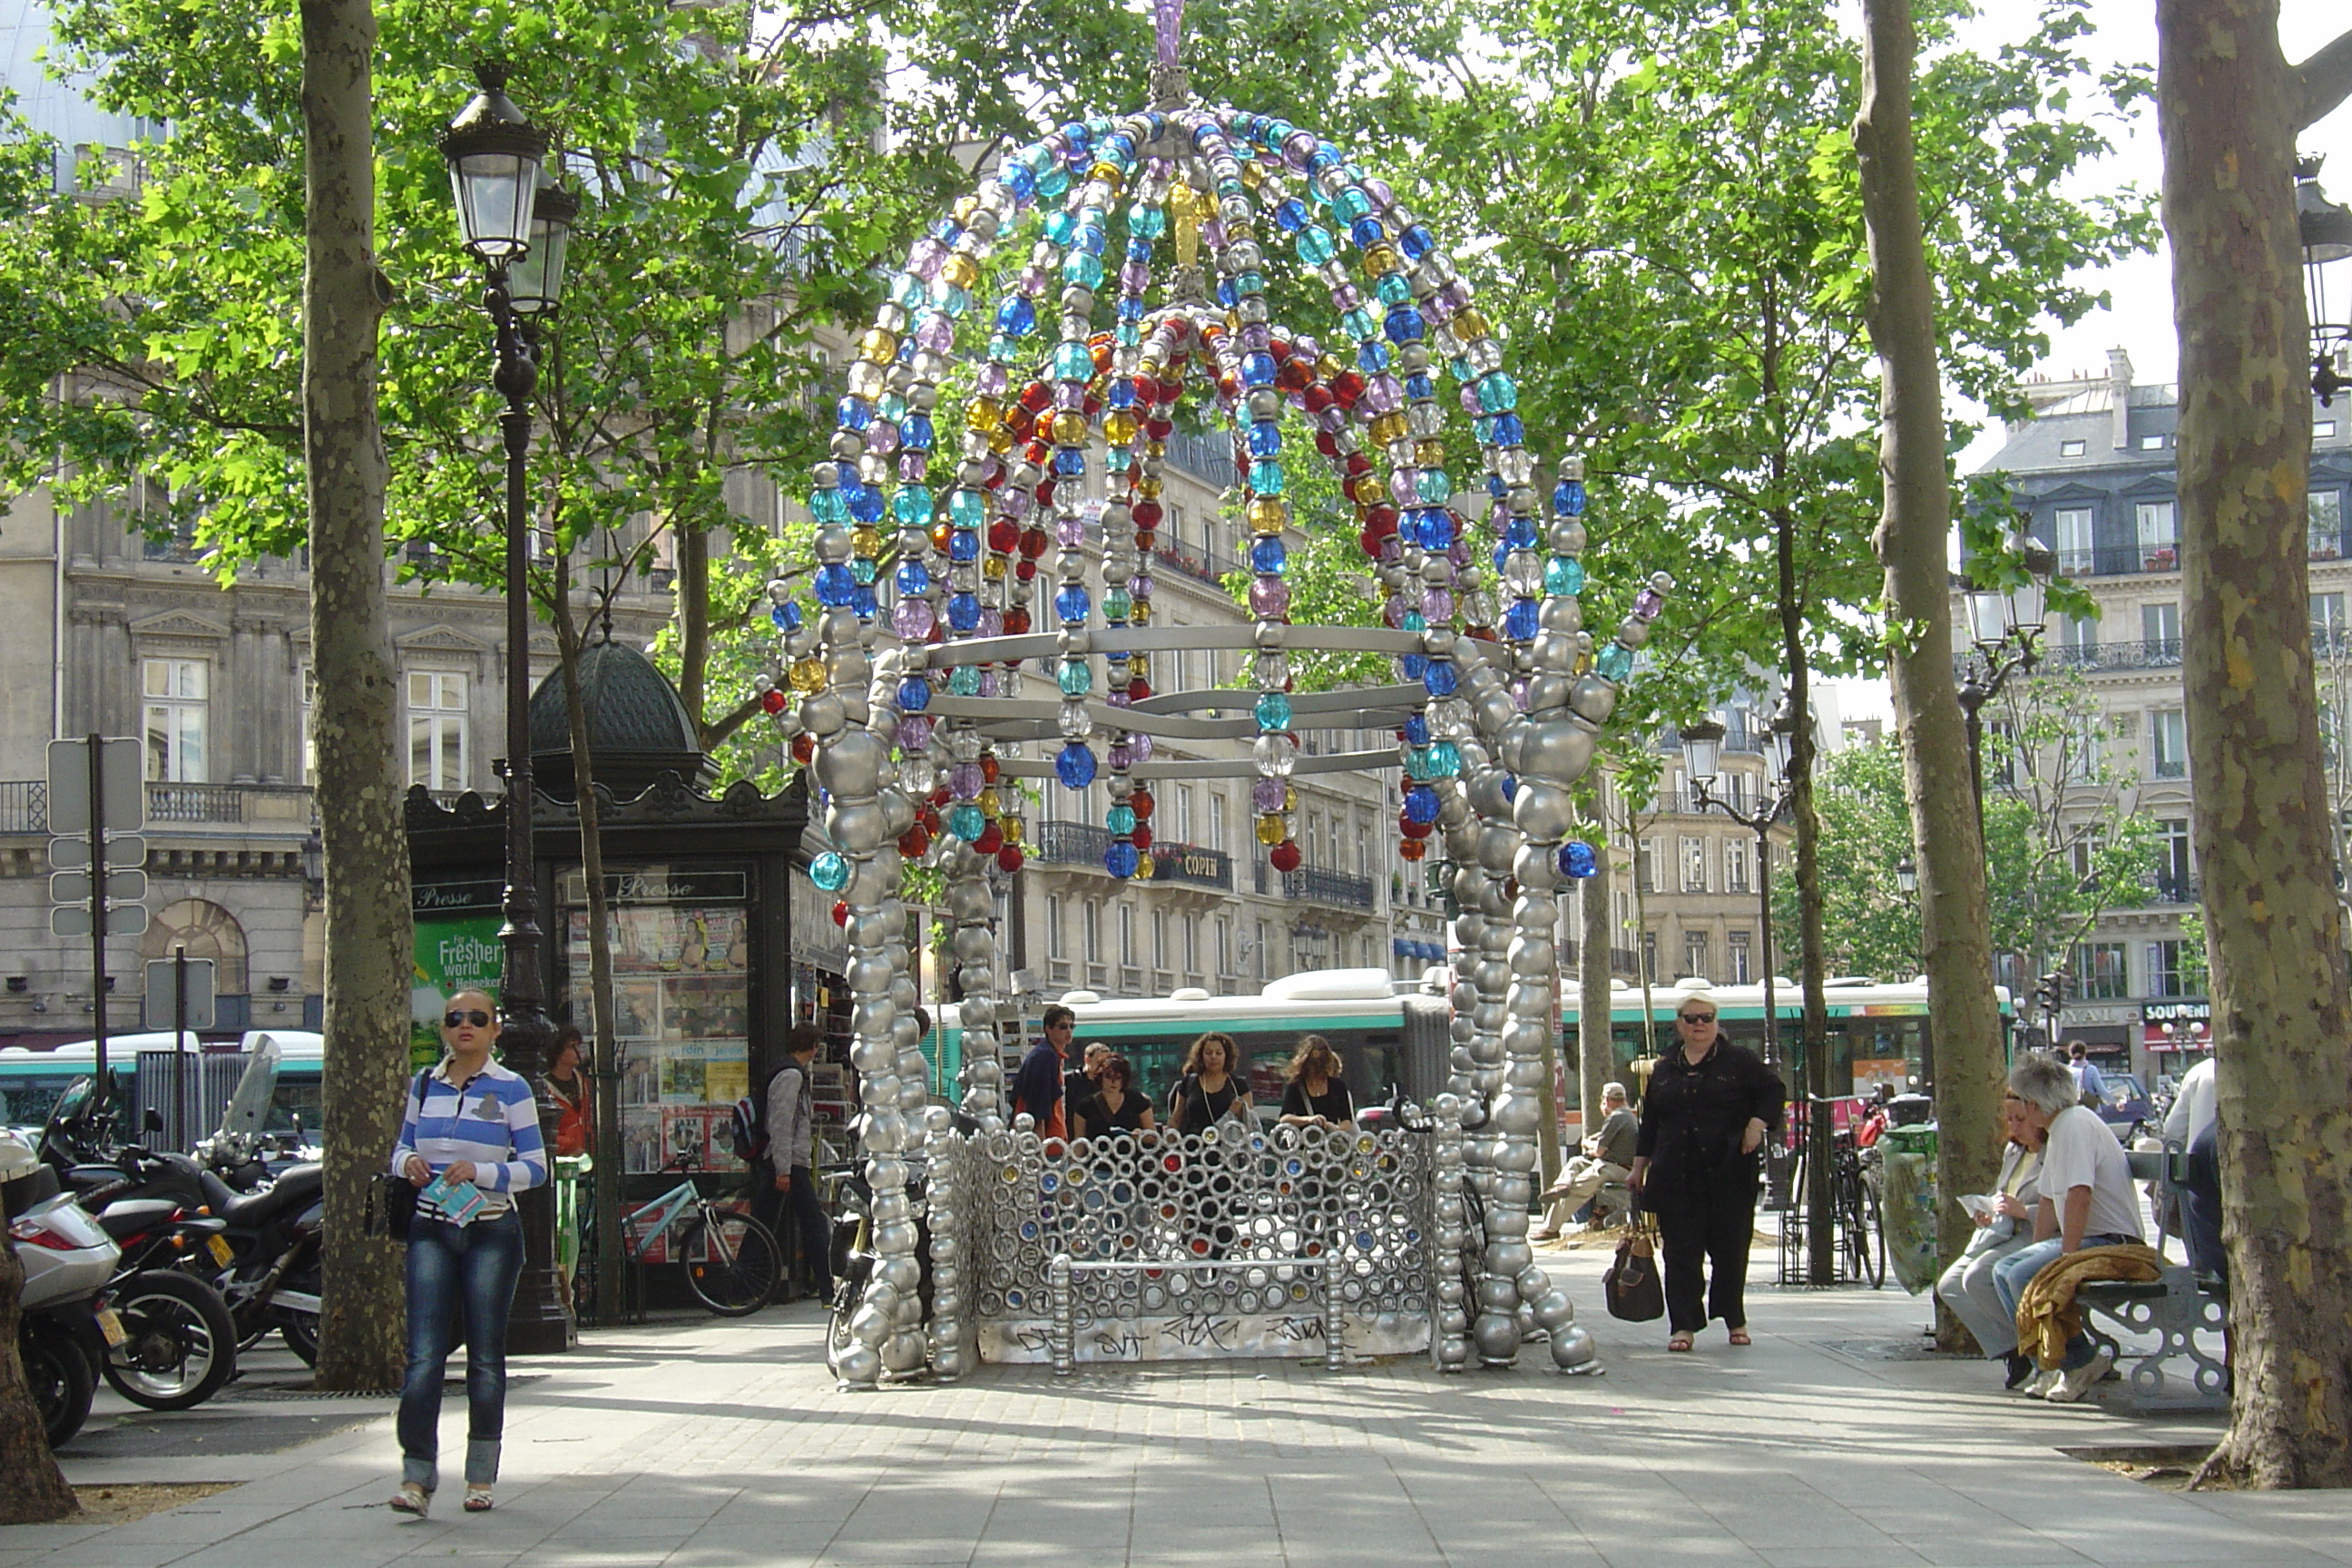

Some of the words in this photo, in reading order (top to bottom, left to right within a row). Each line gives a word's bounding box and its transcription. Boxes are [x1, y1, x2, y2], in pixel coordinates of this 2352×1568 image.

[1185, 855, 1218, 877] COPIN
[618, 876, 695, 897] Presse
[417, 887, 473, 907] Presse
[439, 938, 502, 965] Fresher
[444, 960, 480, 976] world
[2031, 1006, 2116, 1024] RYAL
[2145, 1004, 2210, 1021] SOUENI
